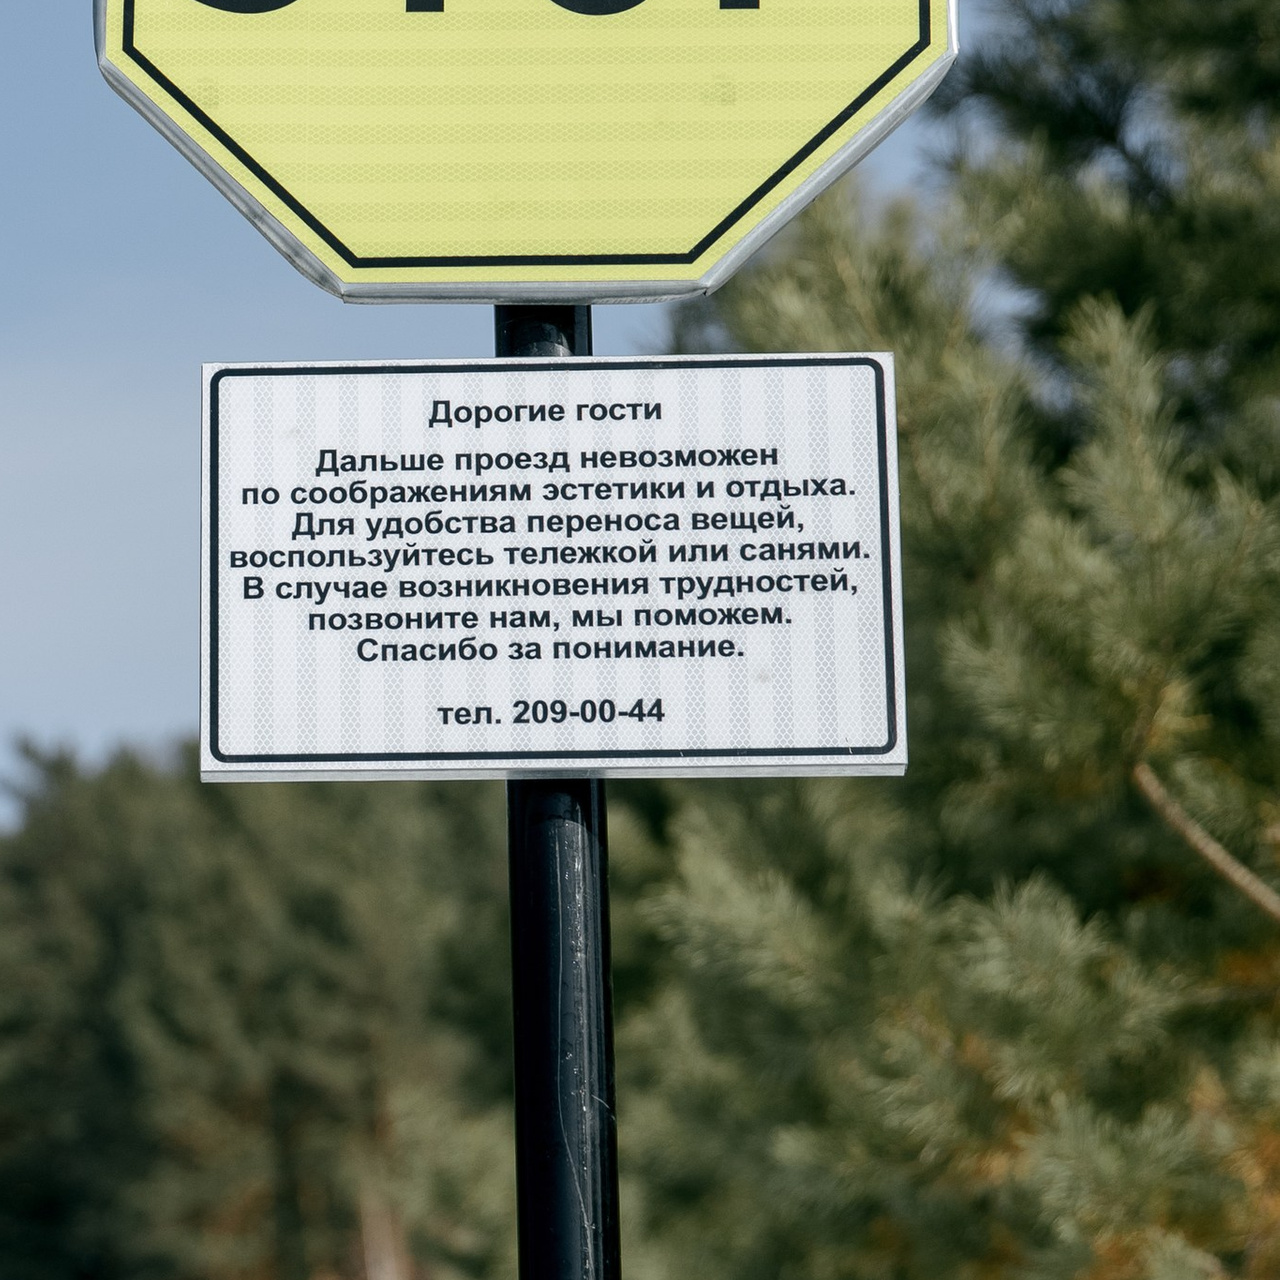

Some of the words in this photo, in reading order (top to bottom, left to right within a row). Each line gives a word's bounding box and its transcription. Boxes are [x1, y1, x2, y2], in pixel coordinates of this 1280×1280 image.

[428, 400, 565, 429] Дорогие
[576, 402, 662, 421] гости
[315, 449, 444, 478] Дальше
[455, 451, 571, 476] проезд
[580, 447, 778, 469] невозможен
[242, 487, 280, 505] по
[290, 479, 531, 510] соображениям
[542, 481, 685, 501] эстетики
[696, 481, 715, 499] и
[725, 478, 856, 502] отдыха.
[291, 512, 355, 541] Для
[365, 509, 516, 542] удобства
[527, 513, 680, 539] переноса
[691, 504, 804, 534] вещей,
[230, 542, 494, 573] воспользуйтесь
[503, 538, 657, 565] тележкой
[668, 543, 729, 563] или
[739, 541, 870, 562] санями.
[243, 576, 265, 600] В
[275, 580, 388, 606] случае
[399, 577, 649, 598] возникновения
[658, 567, 858, 600] трудностей,
[308, 611, 479, 631] позвоните
[490, 610, 560, 632] нам,
[572, 609, 623, 627] мы
[634, 606, 792, 627] поможем.
[356, 636, 498, 662] Спасибо
[508, 642, 542, 660] за
[553, 639, 744, 660] понимание.
[437, 706, 502, 725] тел.
[512, 698, 666, 724] 209-00-44
